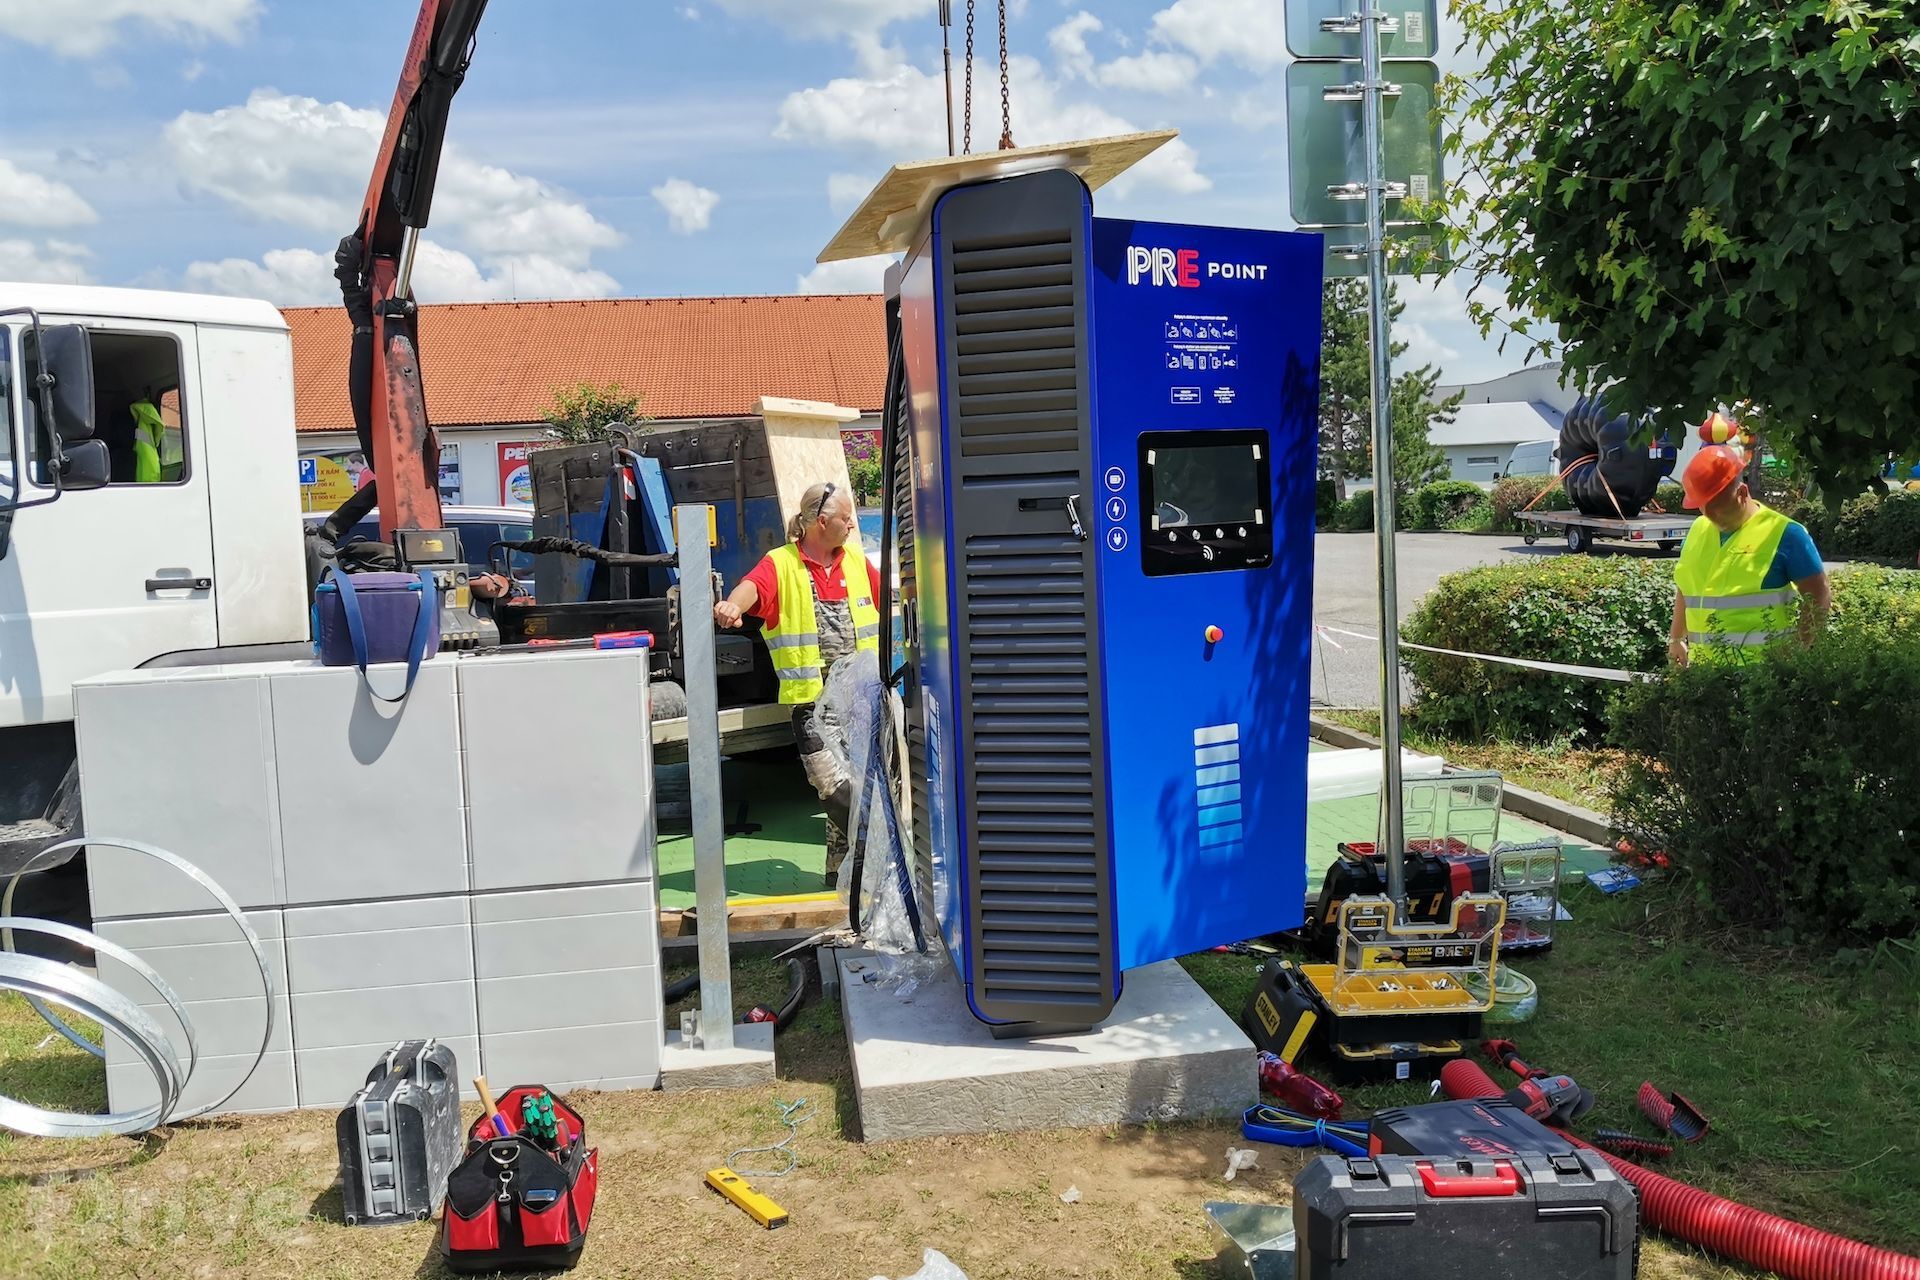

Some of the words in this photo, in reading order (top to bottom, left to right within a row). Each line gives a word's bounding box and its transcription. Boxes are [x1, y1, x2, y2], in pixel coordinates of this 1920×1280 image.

[1127, 245, 1200, 288] PRE
[1207, 262, 1268, 280] POINT
[301, 460, 311, 475] P
[1258, 996, 1279, 1030] STANLEY
